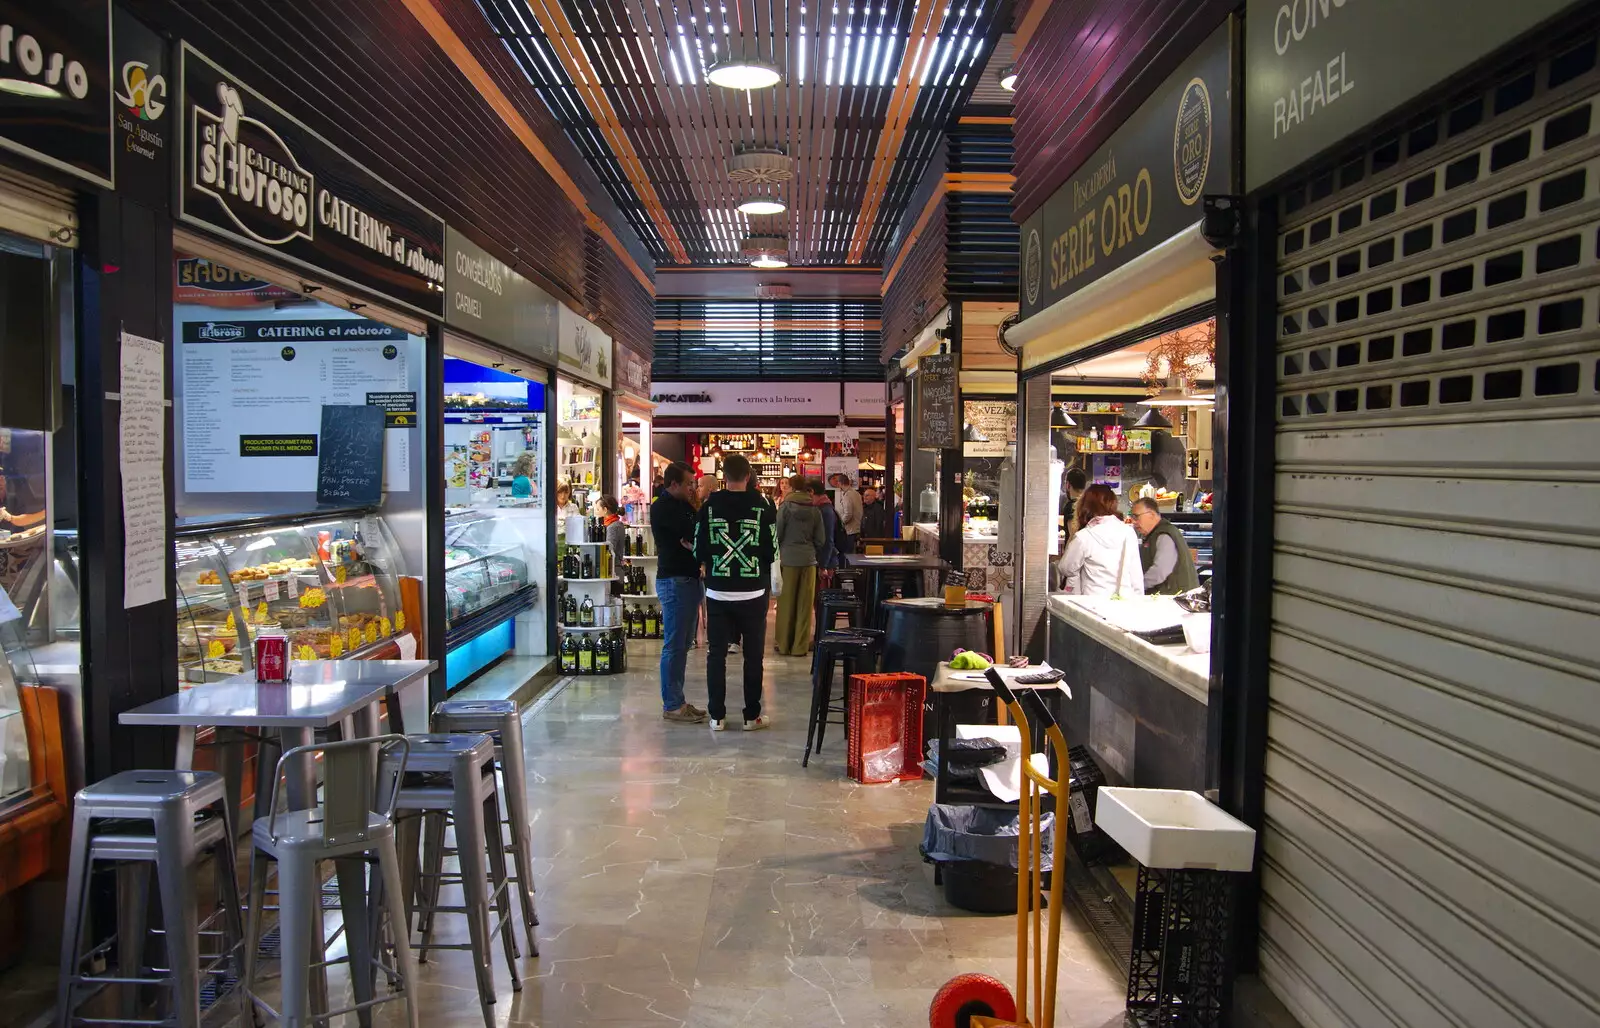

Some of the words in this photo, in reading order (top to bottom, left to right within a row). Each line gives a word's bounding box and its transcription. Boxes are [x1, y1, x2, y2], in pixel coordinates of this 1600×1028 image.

[1273, 51, 1354, 139] RAFAEL
[118, 113, 133, 133] San
[204, 123, 216, 145] el
[126, 134, 155, 160] Gourmet
[1182, 133, 1201, 165] ORO
[247, 148, 308, 194] CATERING
[317, 189, 392, 257] CATERING
[393, 237, 405, 265] el
[406, 247, 444, 283] sabroso
[1050, 209, 1096, 290] SERIE
[1101, 167, 1152, 257] ORO
[455, 250, 502, 296] CONGELADOS
[257, 326, 324, 337] CATERING
[329, 326, 340, 336] el
[344, 326, 392, 336] sabroso
[775, 395, 783, 403] la
[784, 395, 806, 403] brasa
